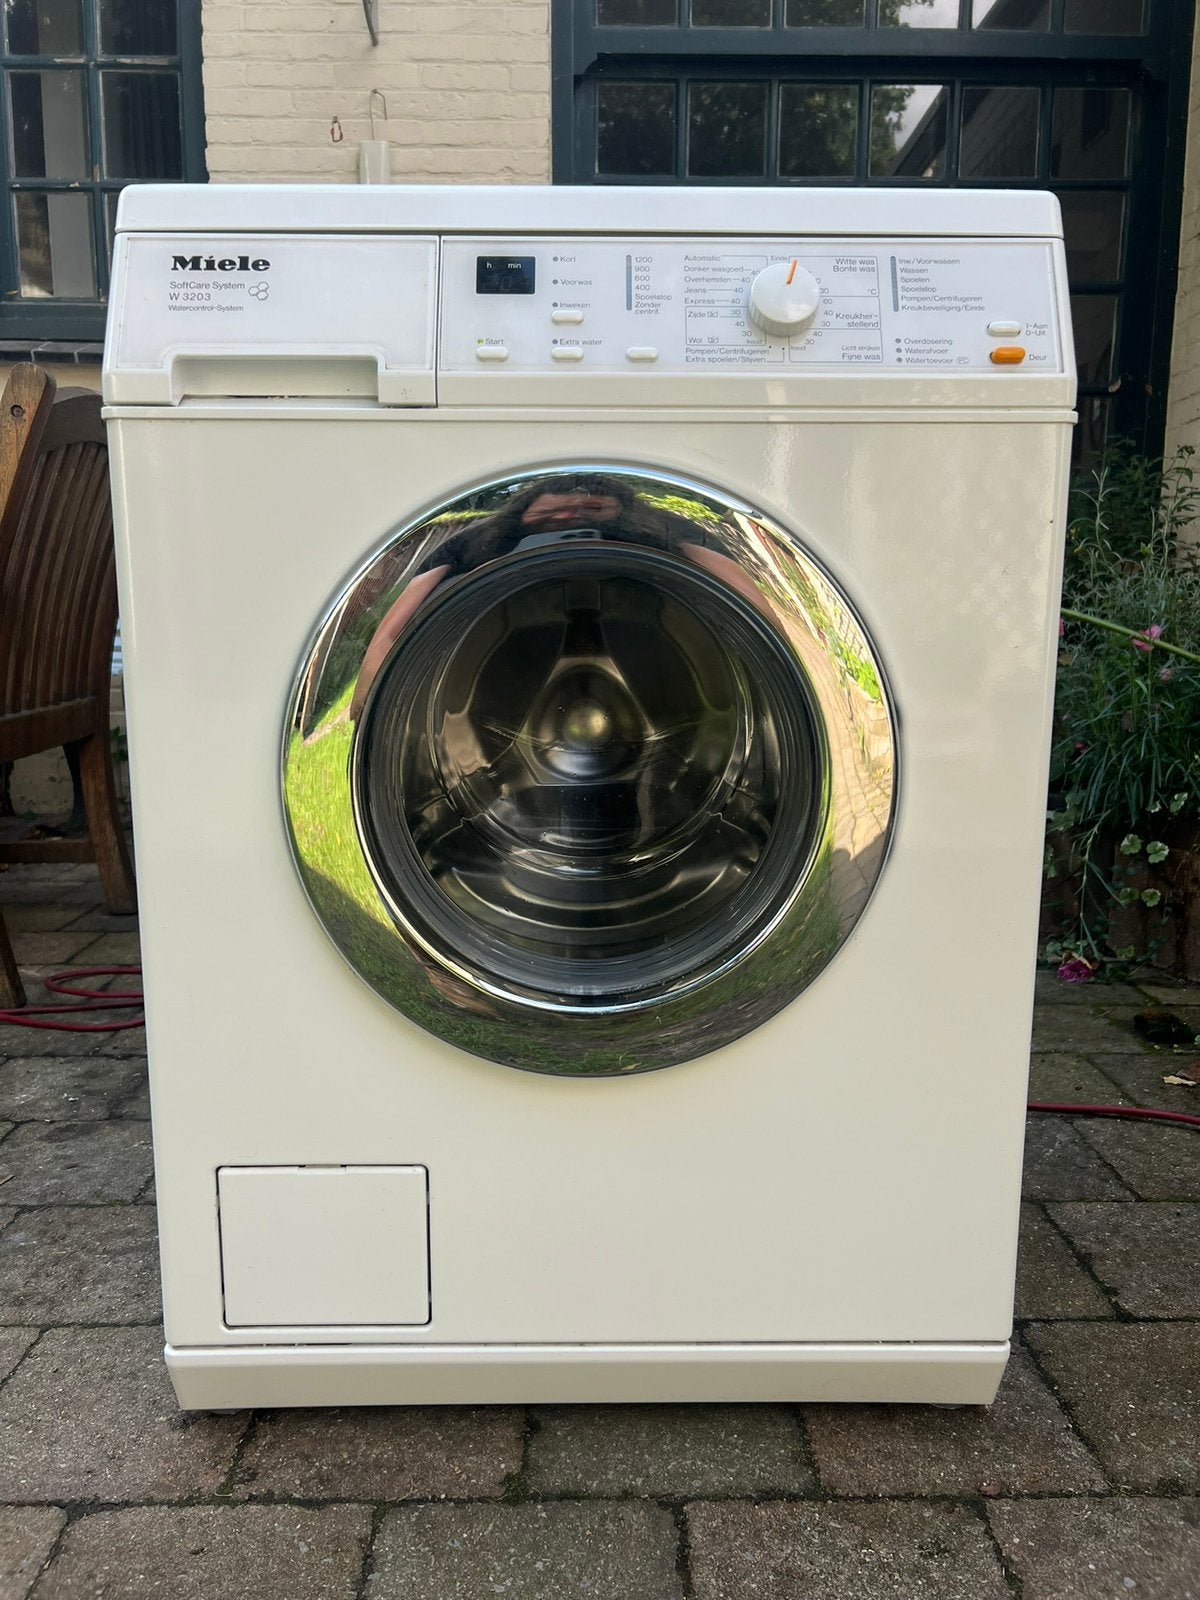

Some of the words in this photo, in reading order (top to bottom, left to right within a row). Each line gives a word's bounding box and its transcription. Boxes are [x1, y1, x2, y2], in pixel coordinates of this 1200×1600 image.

[560, 255, 577, 263] Kort
[834, 258, 857, 266] Witte
[170, 255, 271, 272] Miele
[486, 261, 493, 269] h
[507, 261, 522, 269] min
[634, 265, 650, 273] 900
[832, 265, 857, 273] Bonte
[560, 278, 593, 286] Voorwas
[634, 274, 651, 282] 600
[683, 275, 732, 283] Overhemden
[740, 276, 751, 284] 40
[900, 276, 930, 284] Spoelen
[169, 280, 211, 290] SoftCare
[211, 281, 246, 291] System
[900, 285, 938, 293] Spoelstop
[169, 292, 181, 301] W
[182, 292, 212, 301] 3203
[634, 293, 673, 302] Spoelstop
[900, 294, 983, 303] Pompen/Centrifugeren
[559, 301, 591, 309] Inweken
[634, 301, 662, 309] Zonder
[684, 297, 716, 305] Express
[730, 297, 741, 305] 40
[167, 304, 244, 313] Watercontrol-System
[901, 304, 986, 312] Kreukbeveiliging/Einde
[687, 310, 707, 319] Zijde
[823, 309, 834, 317] 40
[734, 320, 745, 328] 40
[820, 320, 831, 328] 30
[812, 330, 823, 338] 40
[485, 337, 504, 345] Start
[559, 338, 580, 346] Extra
[688, 336, 703, 344] Wol
[804, 338, 815, 346] 30
[903, 337, 953, 345] Overdosering
[685, 347, 770, 355] Pompen/Centrifugeren
[904, 347, 949, 355] Waterafvoer
[685, 355, 706, 363] Extra
[841, 352, 862, 361] Fijne
[905, 356, 954, 364] Watertoevoer
